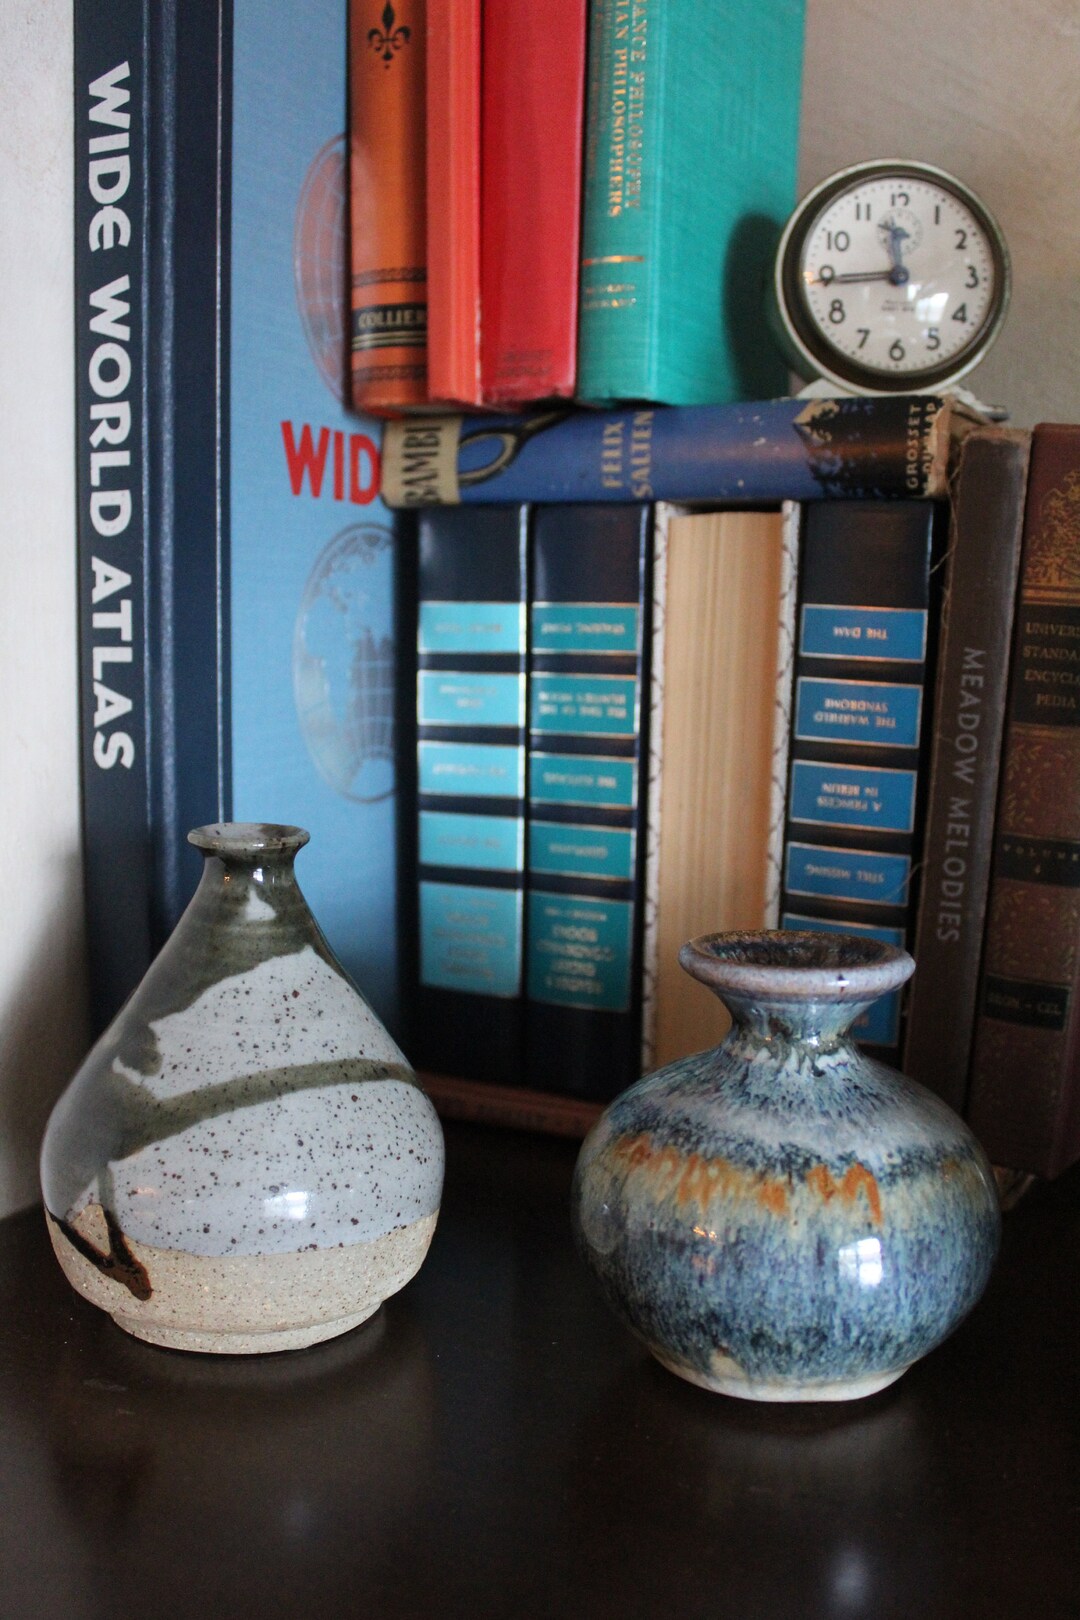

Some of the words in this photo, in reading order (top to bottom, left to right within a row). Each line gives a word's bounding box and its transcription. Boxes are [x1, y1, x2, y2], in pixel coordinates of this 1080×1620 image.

[607, 47, 630, 217] PHILOSOPHERS
[625, 71, 646, 209] PHILOSOPHY
[88, 61, 132, 252] WIDE
[855, 202, 871, 221] 11
[890, 193, 910, 207] 12
[826, 231, 850, 251] 10
[955, 229, 967, 250] 2
[965, 266, 979, 289] 3
[829, 299, 845, 324] 8
[952, 302, 967, 324] 4
[856, 329, 871, 349] 7
[889, 339, 905, 361] 6
[926, 328, 940, 350] 5
[88, 274, 133, 538] WORLD
[600, 422, 625, 489] FELIX
[630, 410, 655, 499] SALTEN
[905, 404, 922, 489] GROSSET
[281, 419, 382, 506] WID
[401, 425, 442, 505] BAMBI
[833, 626, 861, 640] DAM
[866, 627, 888, 641] THE
[91, 555, 135, 770] ATLAS
[824, 698, 888, 713] SYNDROME
[952, 646, 986, 784] MEADOW
[875, 715, 896, 729] THE
[936, 795, 973, 943] MELODIES
